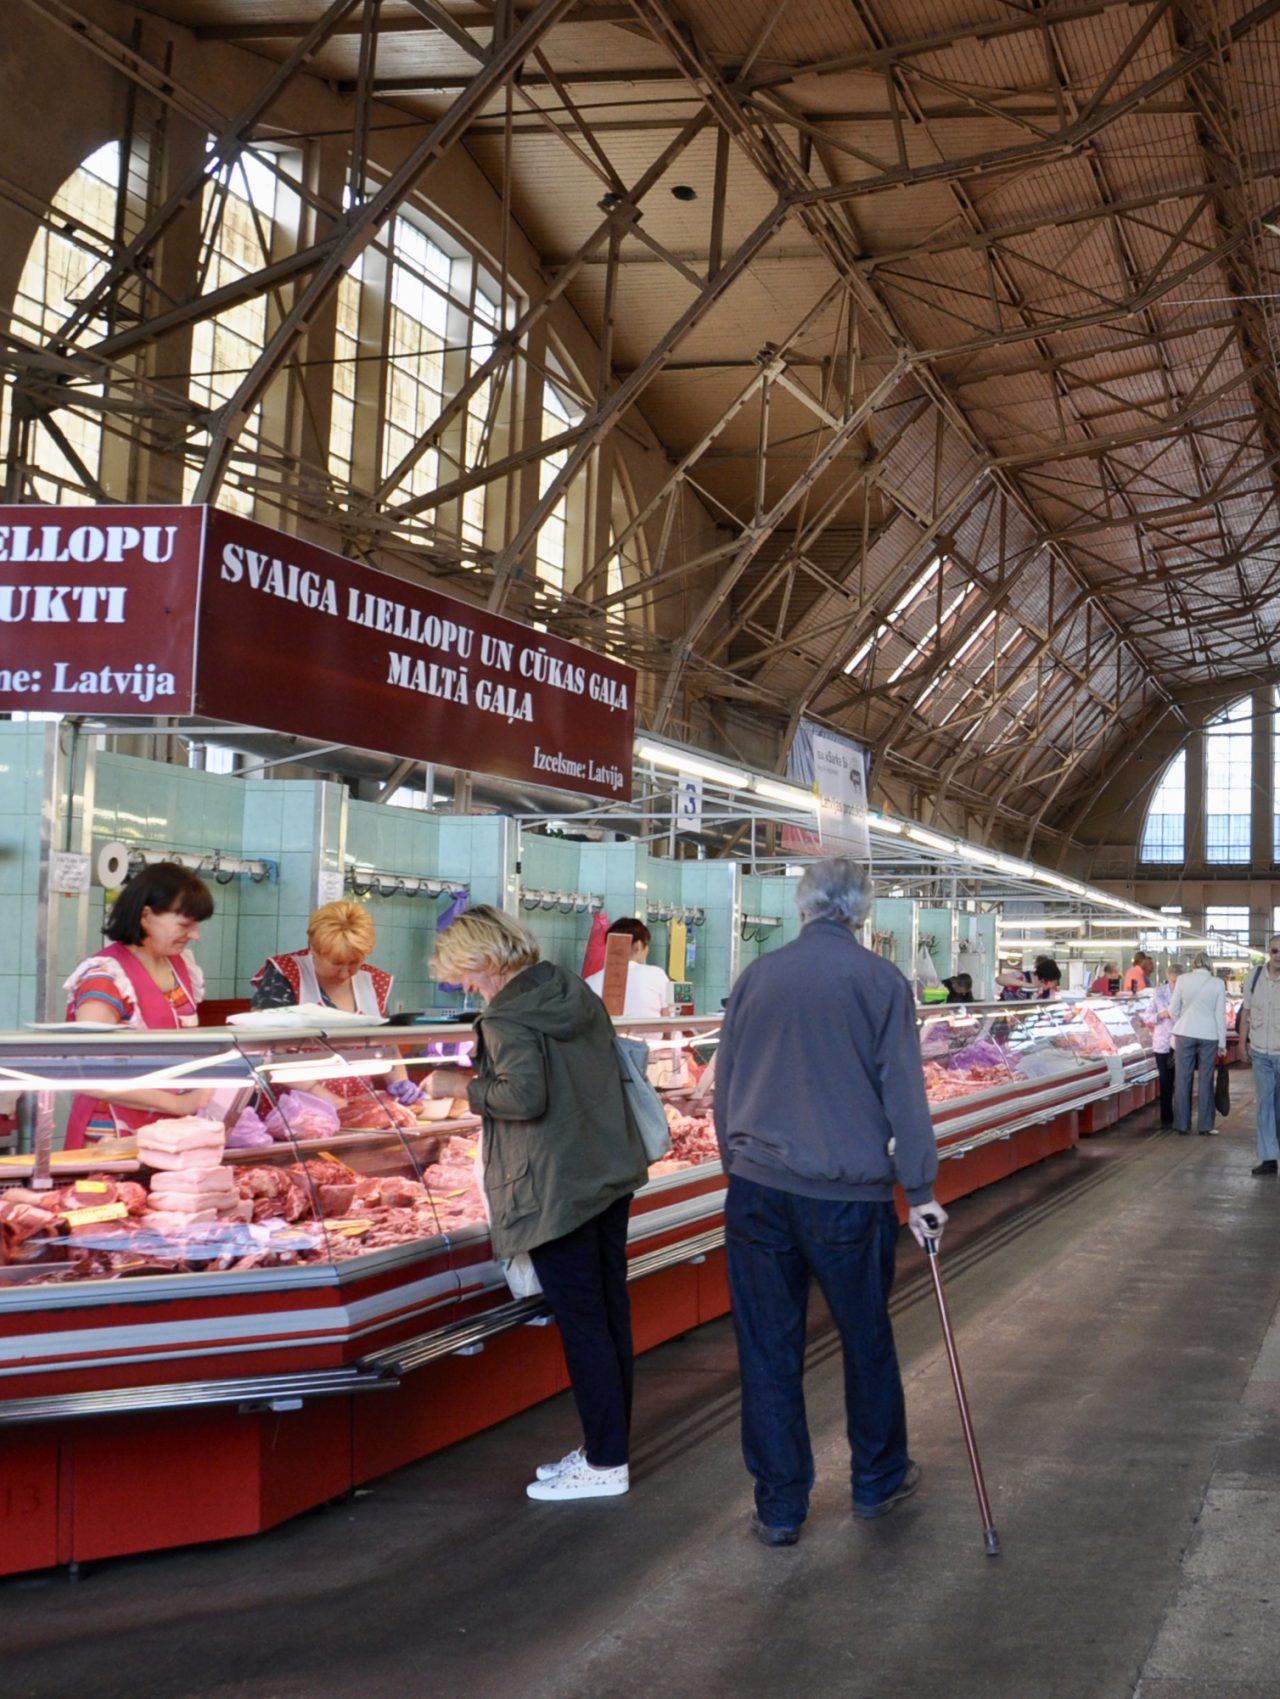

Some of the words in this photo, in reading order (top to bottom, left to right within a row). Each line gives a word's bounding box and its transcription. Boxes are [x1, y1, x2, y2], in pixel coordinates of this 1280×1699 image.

[220, 543, 339, 616] SVAIGA
[347, 587, 474, 659] LIELLOPU
[480, 634, 515, 672] UN
[519, 647, 585, 695] CŪKAS
[589, 673, 628, 712] GAĻA
[52, 662, 176, 702] Latvija
[386, 651, 469, 705] MALTĀ
[475, 679, 534, 724] GAĻA
[532, 746, 586, 778] Izcelsme:
[588, 760, 624, 791] Latvija
